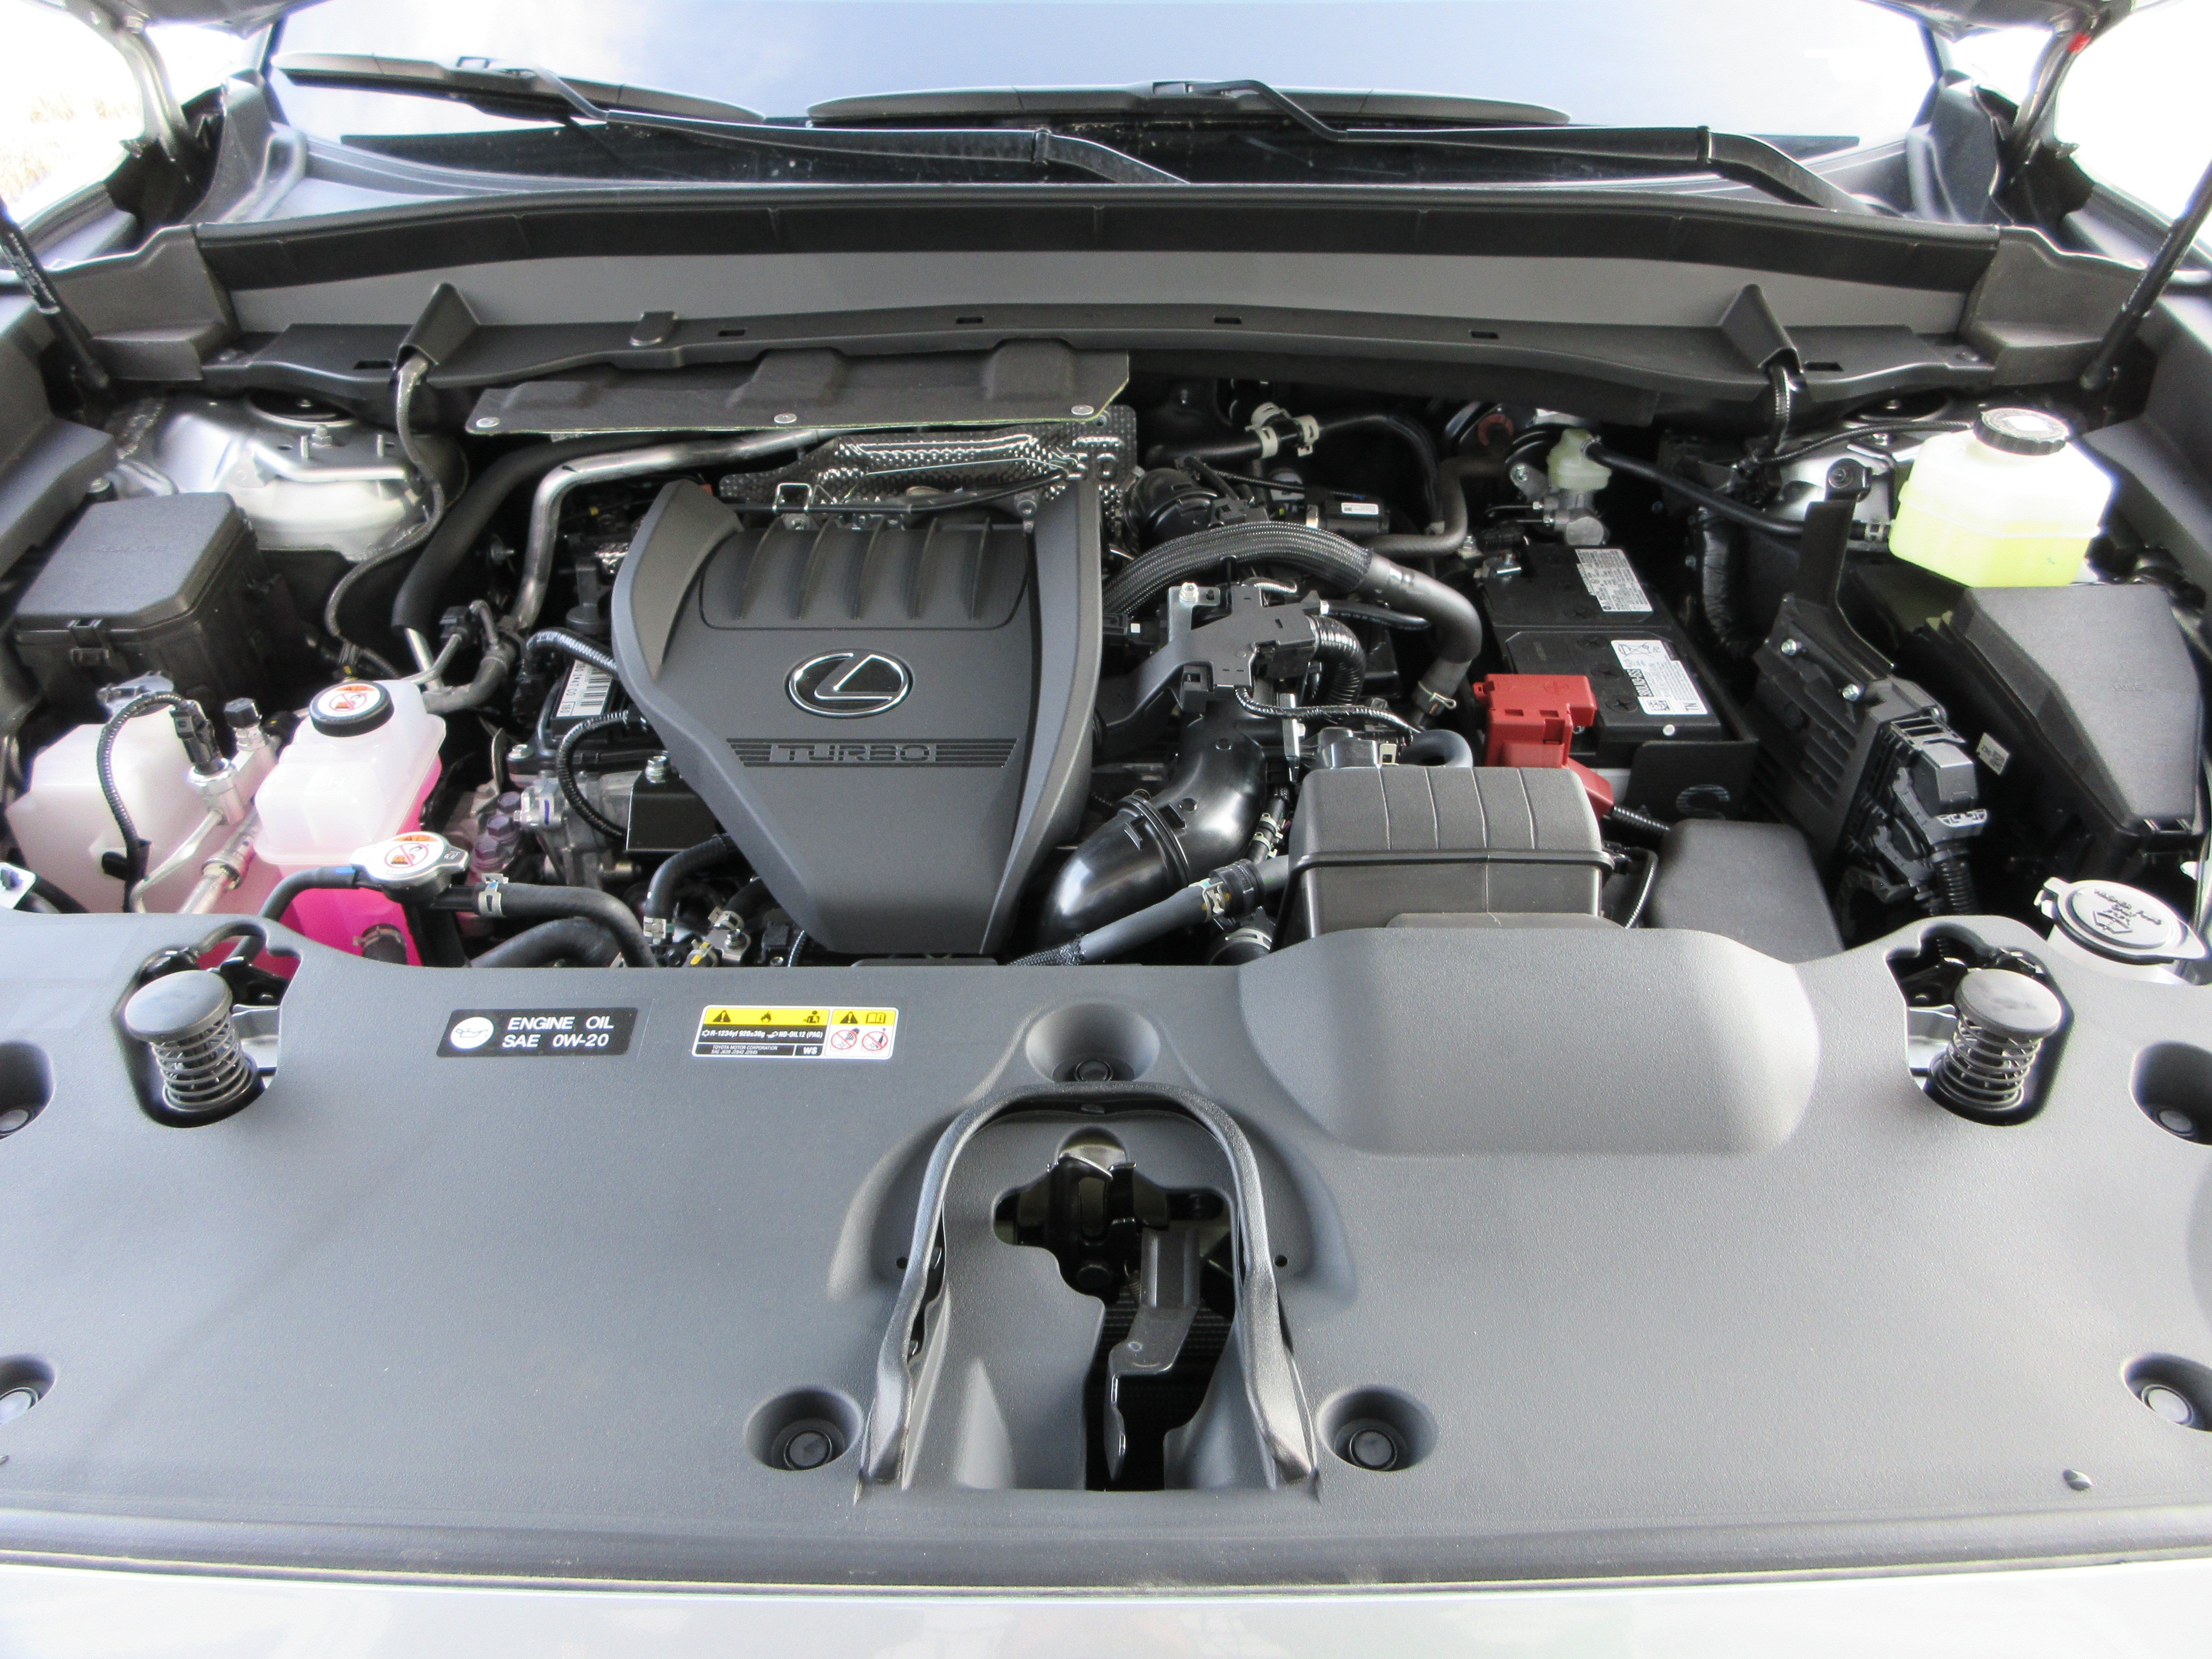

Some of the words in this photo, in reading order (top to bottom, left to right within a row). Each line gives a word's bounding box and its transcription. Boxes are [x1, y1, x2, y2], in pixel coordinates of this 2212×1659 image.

[777, 744, 930, 761] TURBO
[507, 1016, 576, 1030] ENGINE
[585, 1016, 614, 1030] OIL
[502, 1034, 541, 1048] SAE
[552, 1033, 609, 1047] 0W-20
[710, 1030, 738, 1038] R-1234yf
